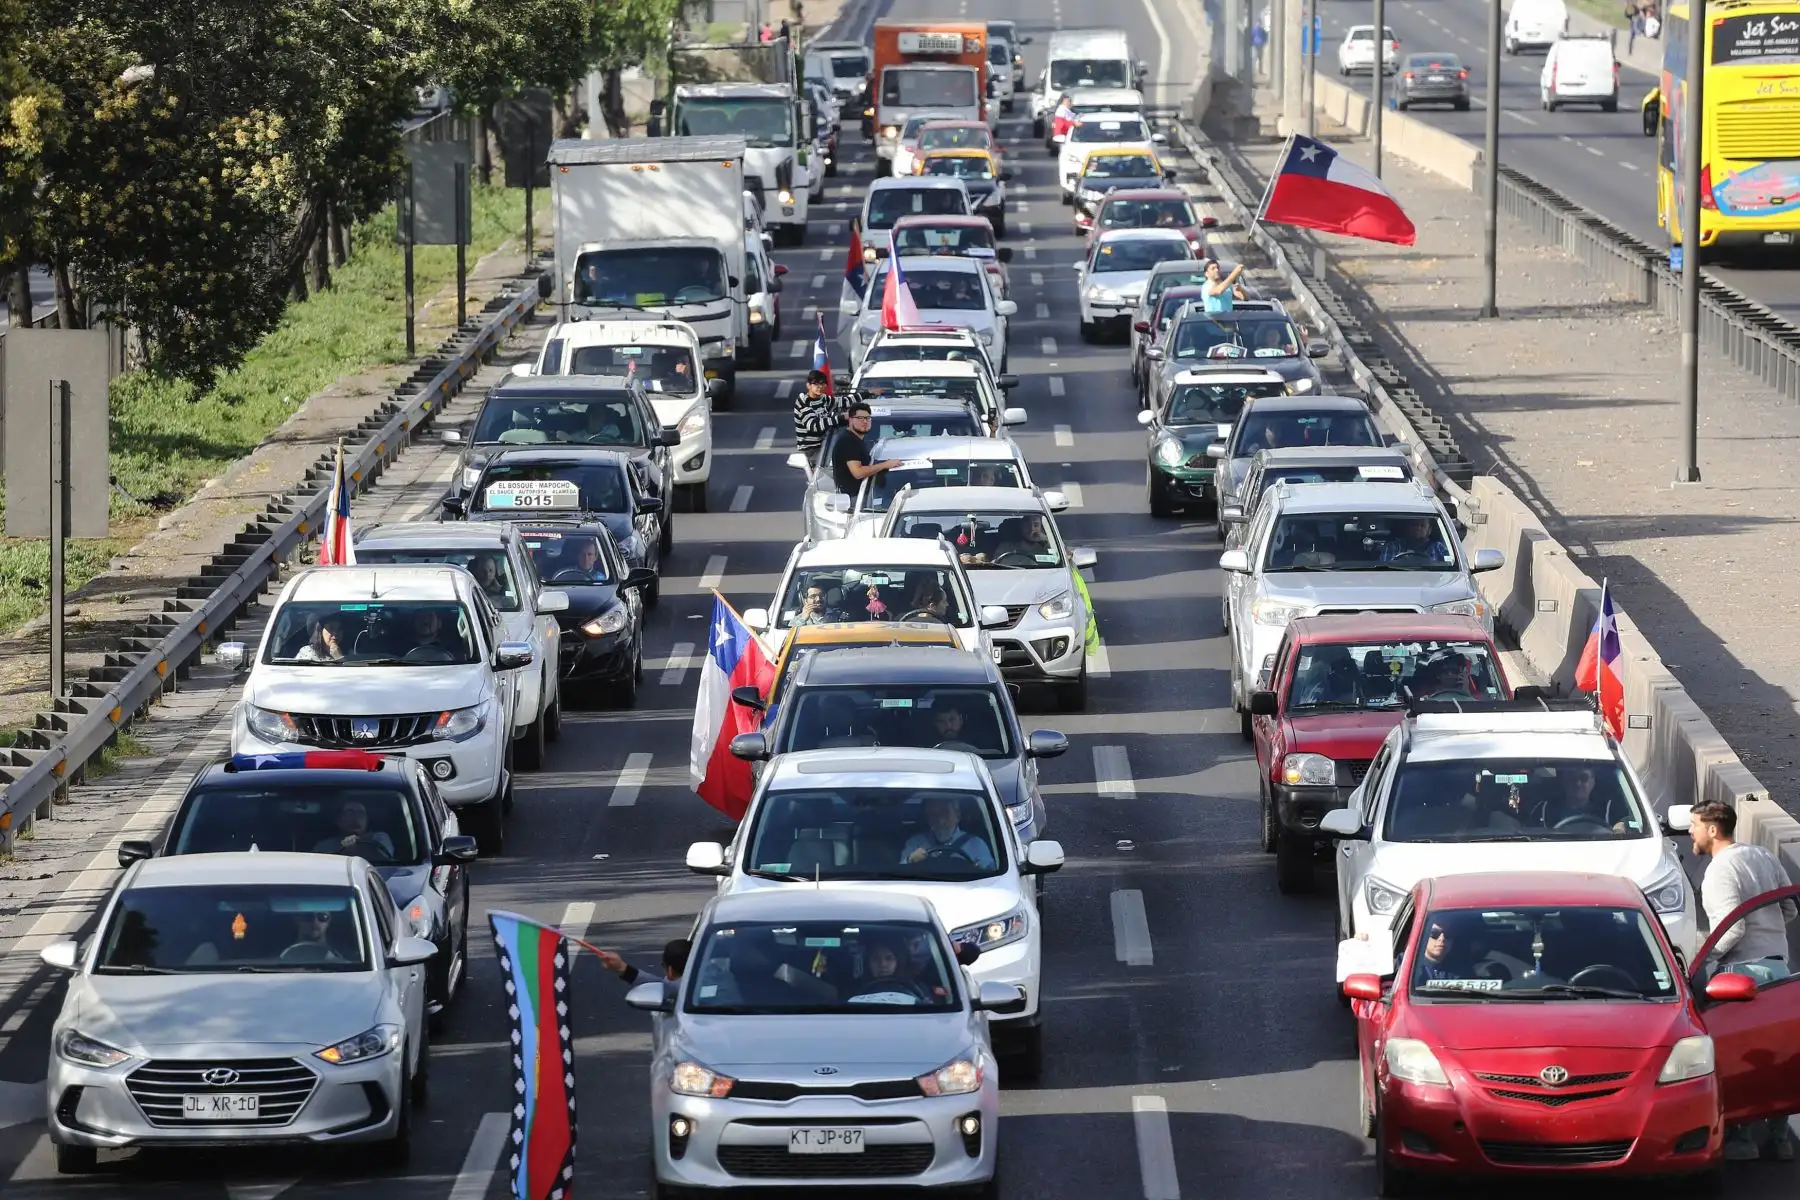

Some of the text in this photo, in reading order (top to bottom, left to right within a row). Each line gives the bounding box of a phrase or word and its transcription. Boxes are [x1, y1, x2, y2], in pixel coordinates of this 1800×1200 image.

[1742, 15, 1799, 39] Jet Sur
[514, 495, 552, 506] 5015
